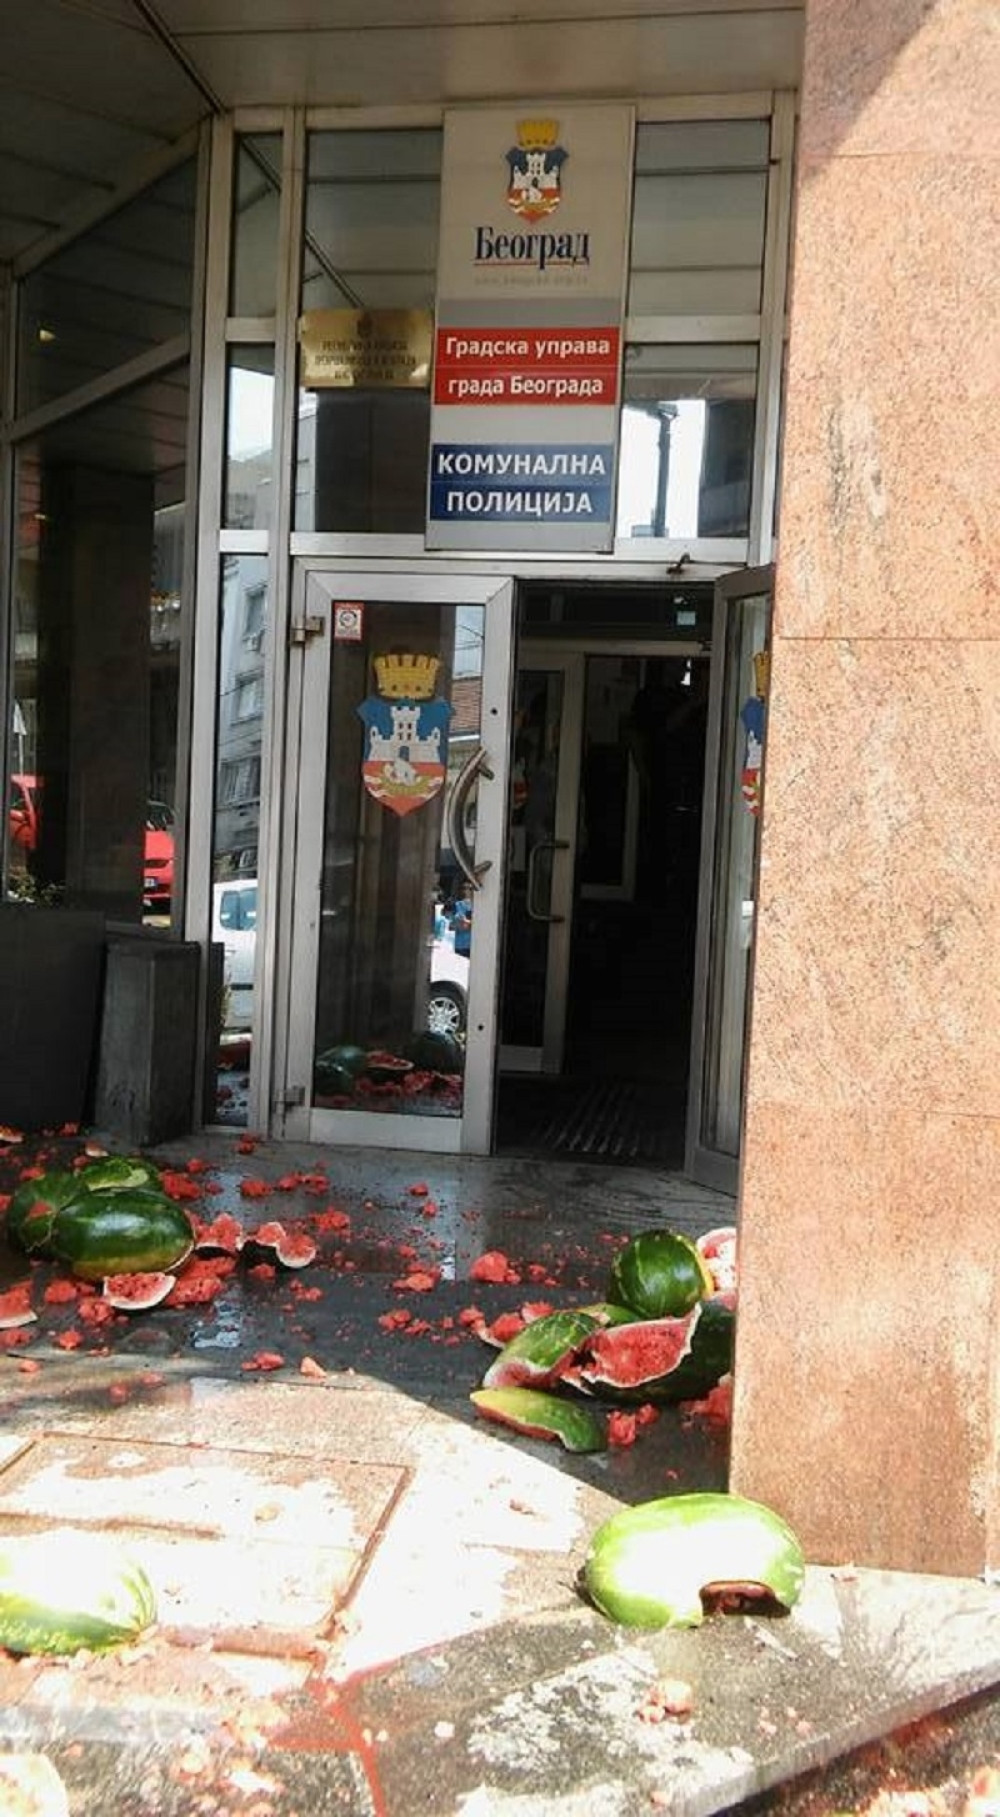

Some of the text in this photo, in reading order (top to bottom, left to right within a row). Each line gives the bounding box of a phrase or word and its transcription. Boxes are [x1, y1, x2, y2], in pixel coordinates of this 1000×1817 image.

[475, 226, 590, 270] Београд
[446, 337, 610, 359] Градска управа
[448, 374, 603, 398] града Београда
[437, 453, 606, 475] КОМУНАЛНА
[446, 491, 593, 516] ПОЛИЦИЈА
